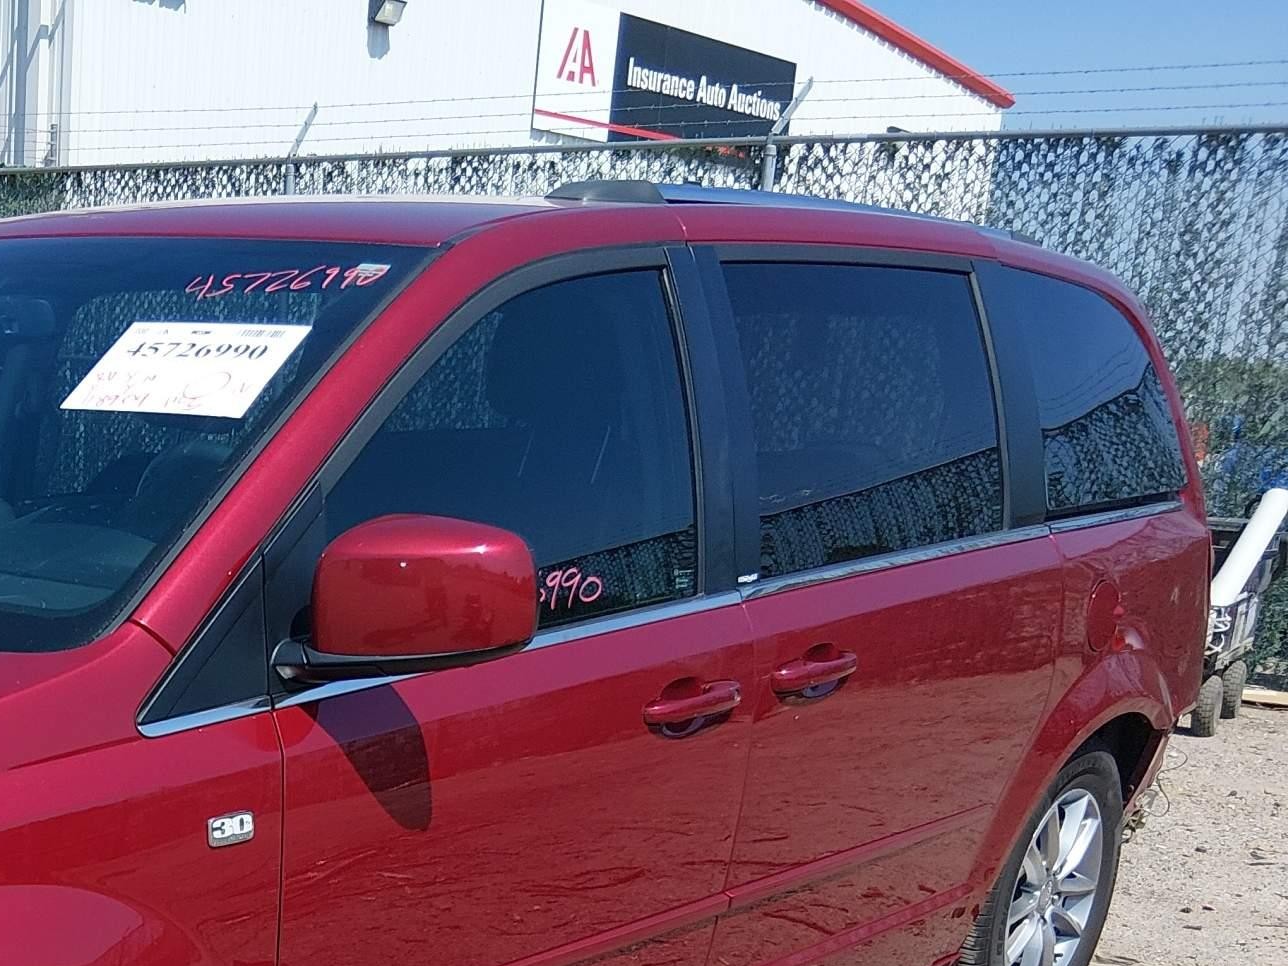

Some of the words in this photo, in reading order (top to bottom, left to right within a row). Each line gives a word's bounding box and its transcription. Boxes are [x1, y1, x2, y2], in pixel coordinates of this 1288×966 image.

[627, 57, 695, 101] Insurance
[696, 75, 727, 109] Auto
[727, 83, 781, 122] Auctions
[128, 342, 268, 360] 45726990
[540, 567, 602, 610] 990
